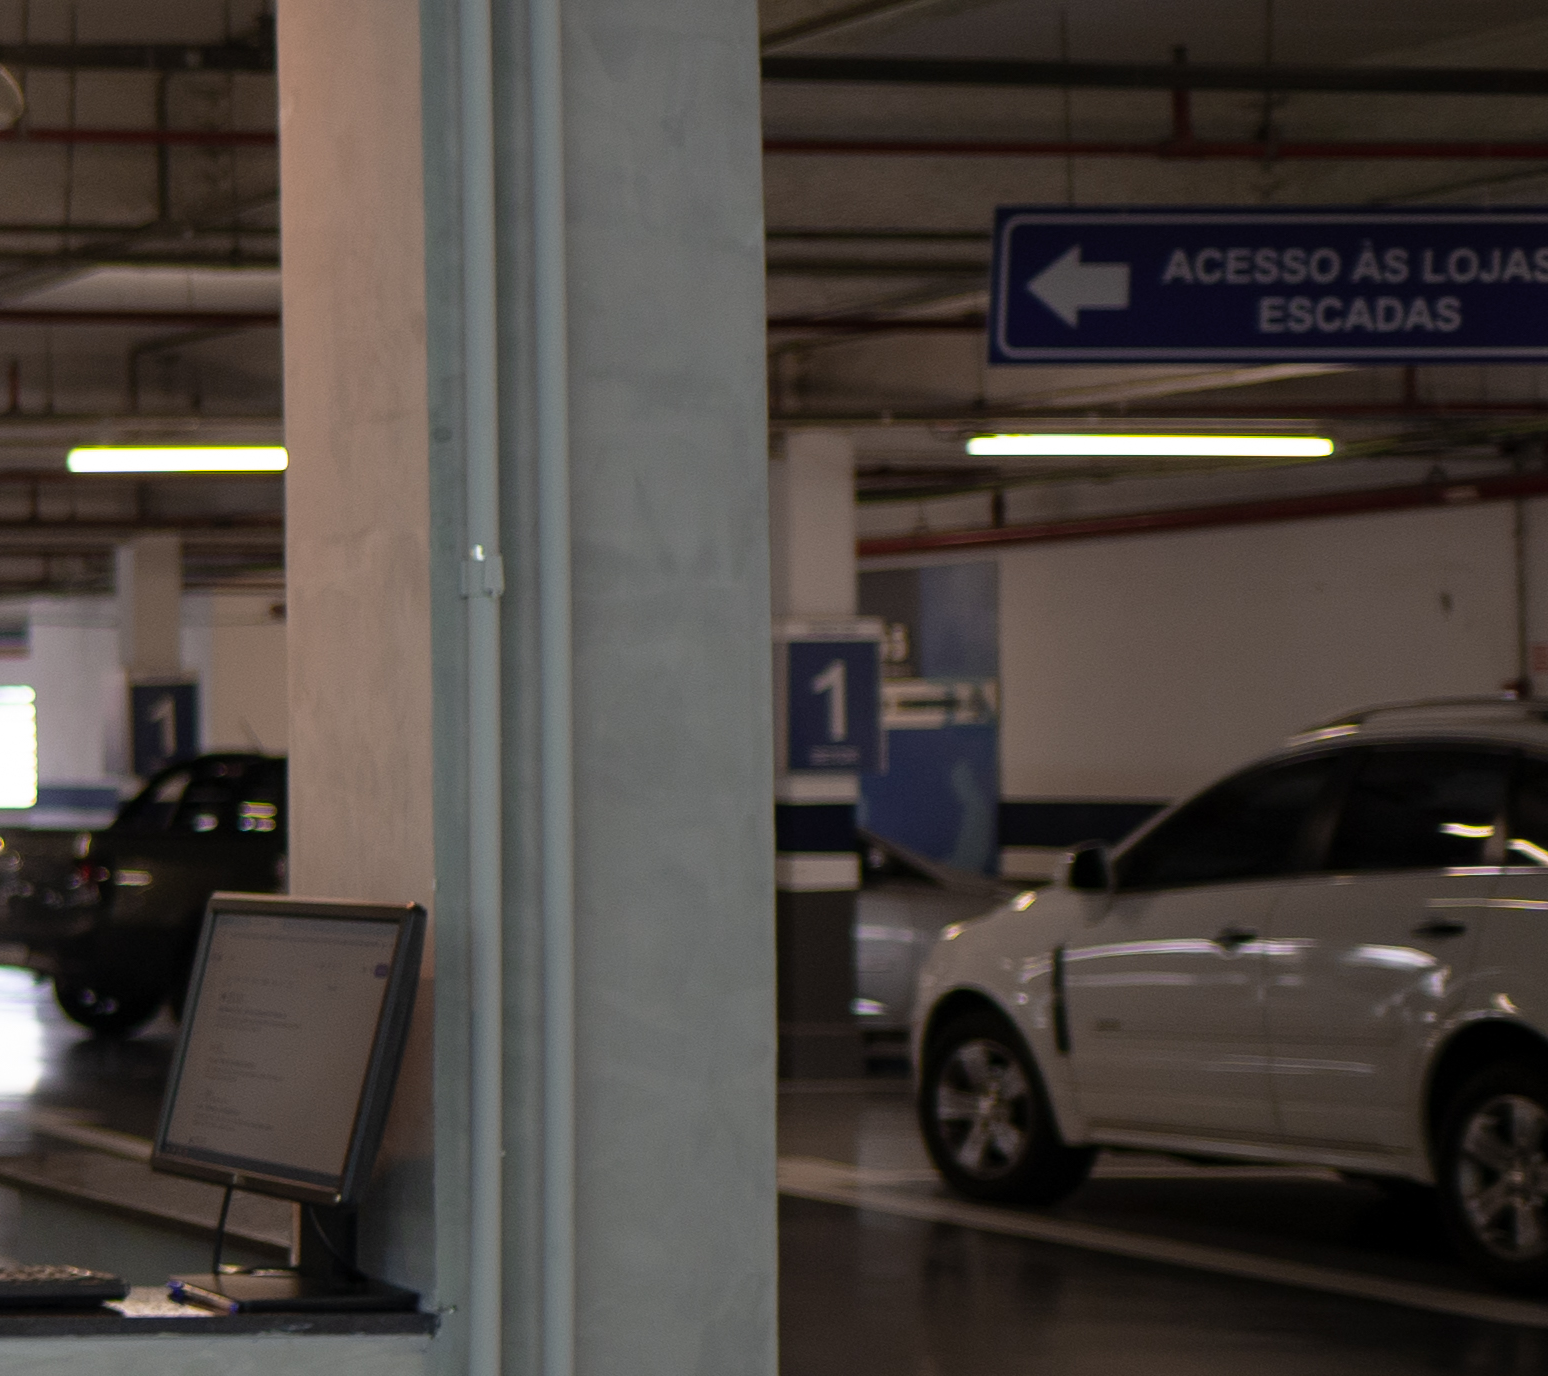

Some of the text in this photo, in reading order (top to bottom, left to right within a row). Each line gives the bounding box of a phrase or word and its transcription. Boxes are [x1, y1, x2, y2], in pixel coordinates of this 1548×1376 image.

[1160, 247, 1342, 285] ACESSO
[1350, 237, 1410, 285] ÀS
[1257, 295, 1463, 334] ESCADAS
[148, 692, 177, 759] 1
[811, 659, 847, 743] 1
